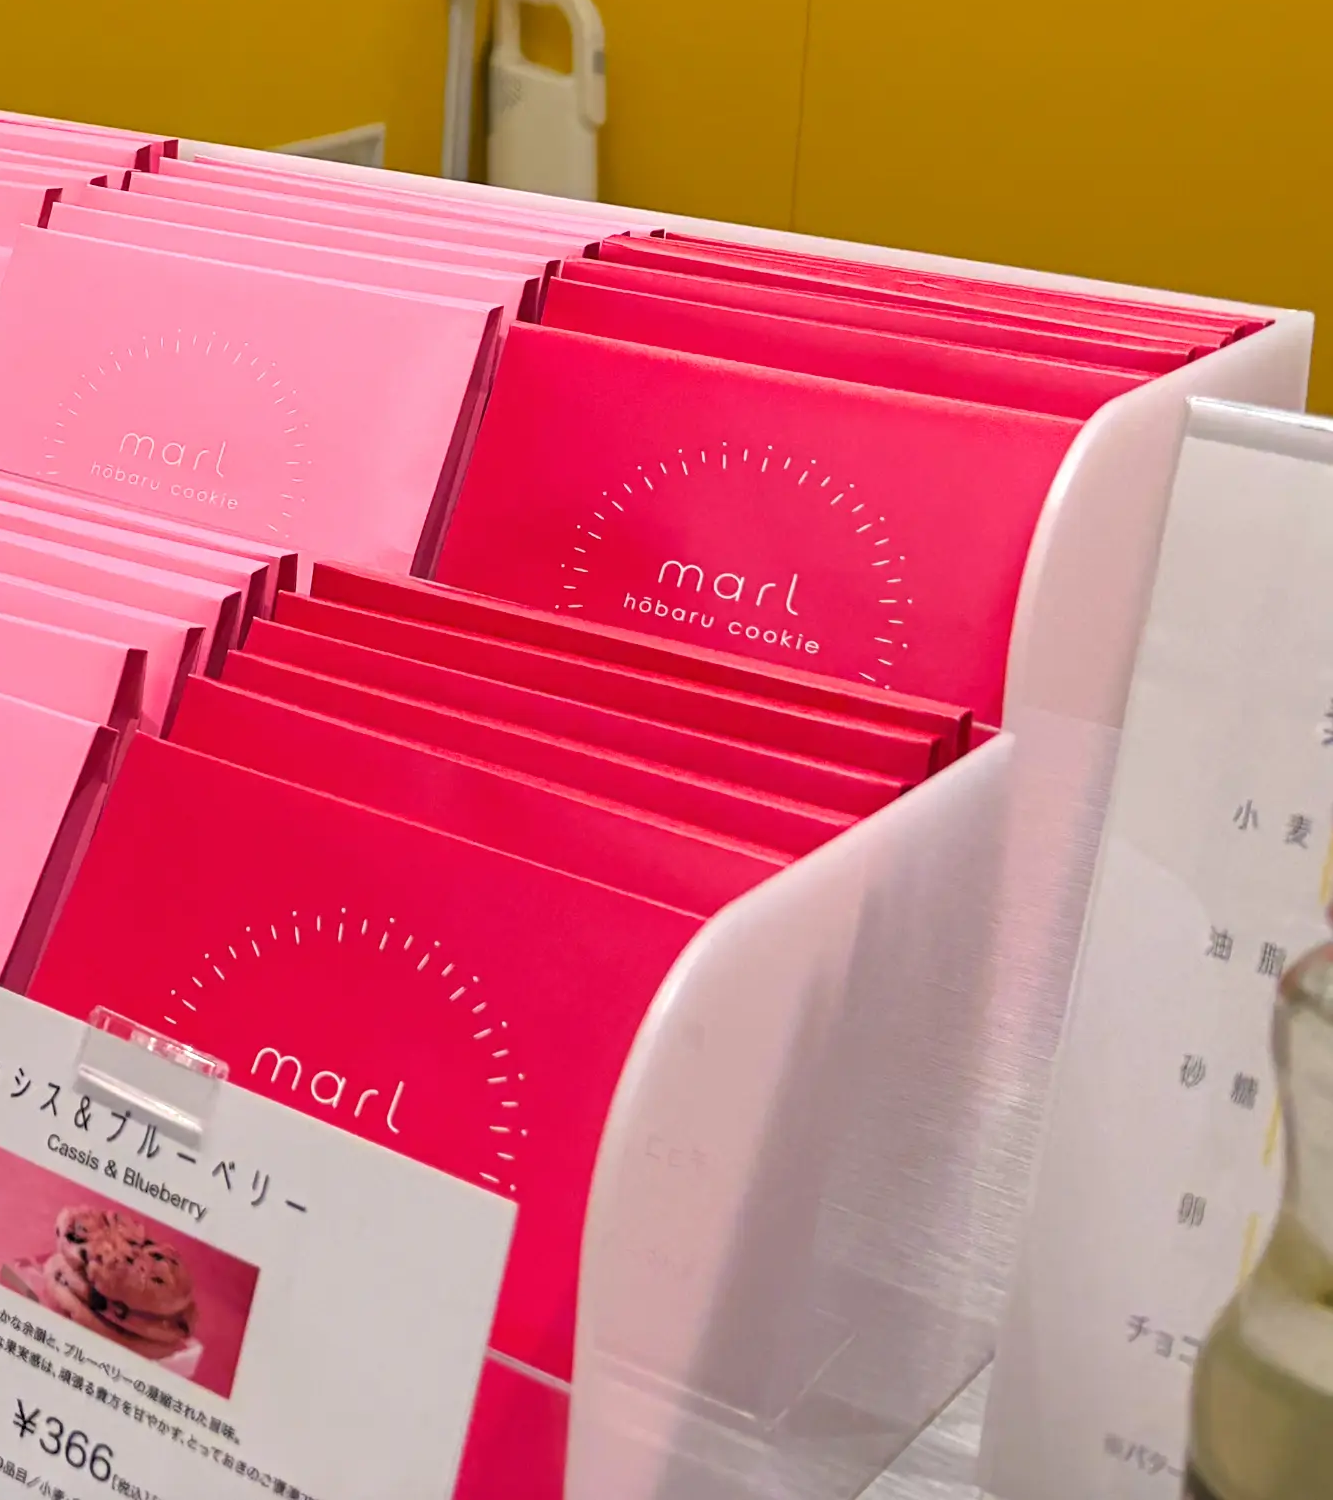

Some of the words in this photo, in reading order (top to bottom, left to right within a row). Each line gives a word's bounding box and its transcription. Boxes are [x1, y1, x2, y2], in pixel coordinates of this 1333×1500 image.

[119, 432, 228, 479] marl
[91, 461, 161, 492] hōbaru
[171, 483, 239, 511] cookie
[657, 560, 799, 616] marl
[623, 592, 715, 629] hōbaru
[728, 620, 820, 655] cookie
[1233, 800, 1313, 849] 小麦
[1205, 924, 1287, 979] 油脂
[251, 1046, 406, 1134] marl
[1180, 1054, 1260, 1111] 砂糖
[47, 1133, 100, 1171] Cassis
[103, 1159, 118, 1179] &
[122, 1167, 207, 1223] Blueberry
[1177, 1192, 1208, 1227] 卵
[13, 1399, 114, 1482] ¥366
